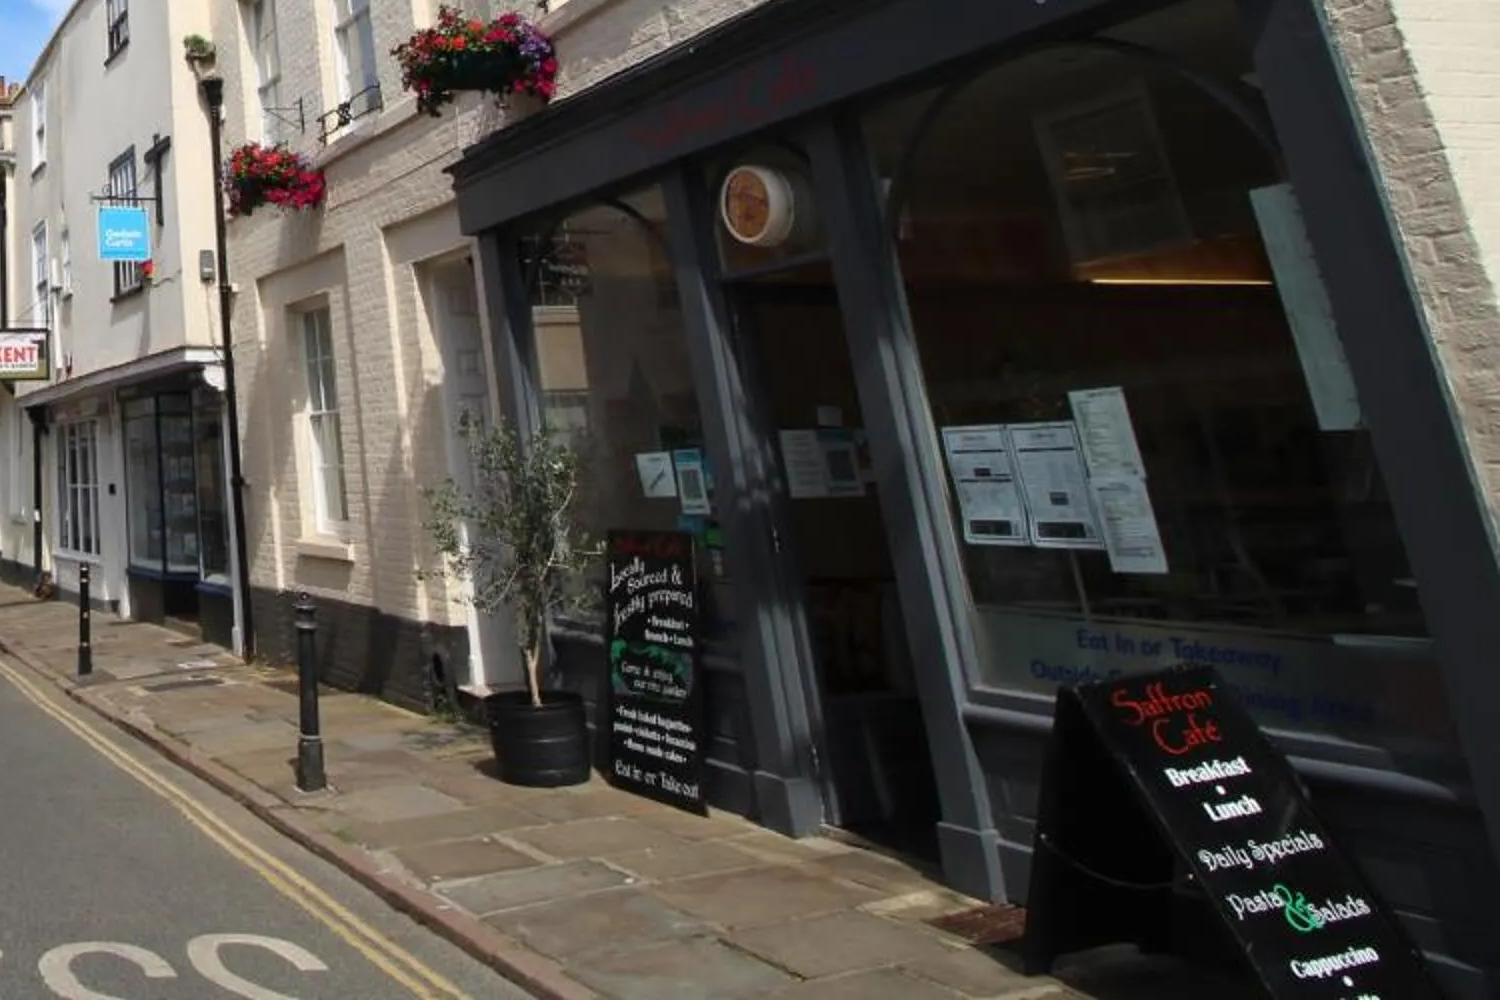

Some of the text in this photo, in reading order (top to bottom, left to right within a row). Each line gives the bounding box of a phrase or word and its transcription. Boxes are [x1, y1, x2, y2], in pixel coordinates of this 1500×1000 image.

[1076, 629, 1281, 675] Eat In or Takeaway
[1111, 681, 1213, 727] Saffron
[1164, 755, 1252, 787] Breakfast
[1202, 794, 1262, 822] Lunch
[1197, 829, 1324, 872] Daily Specials
[1226, 884, 1371, 932] Pasta & Salads
[1290, 946, 1379, 978] Cappuccino
